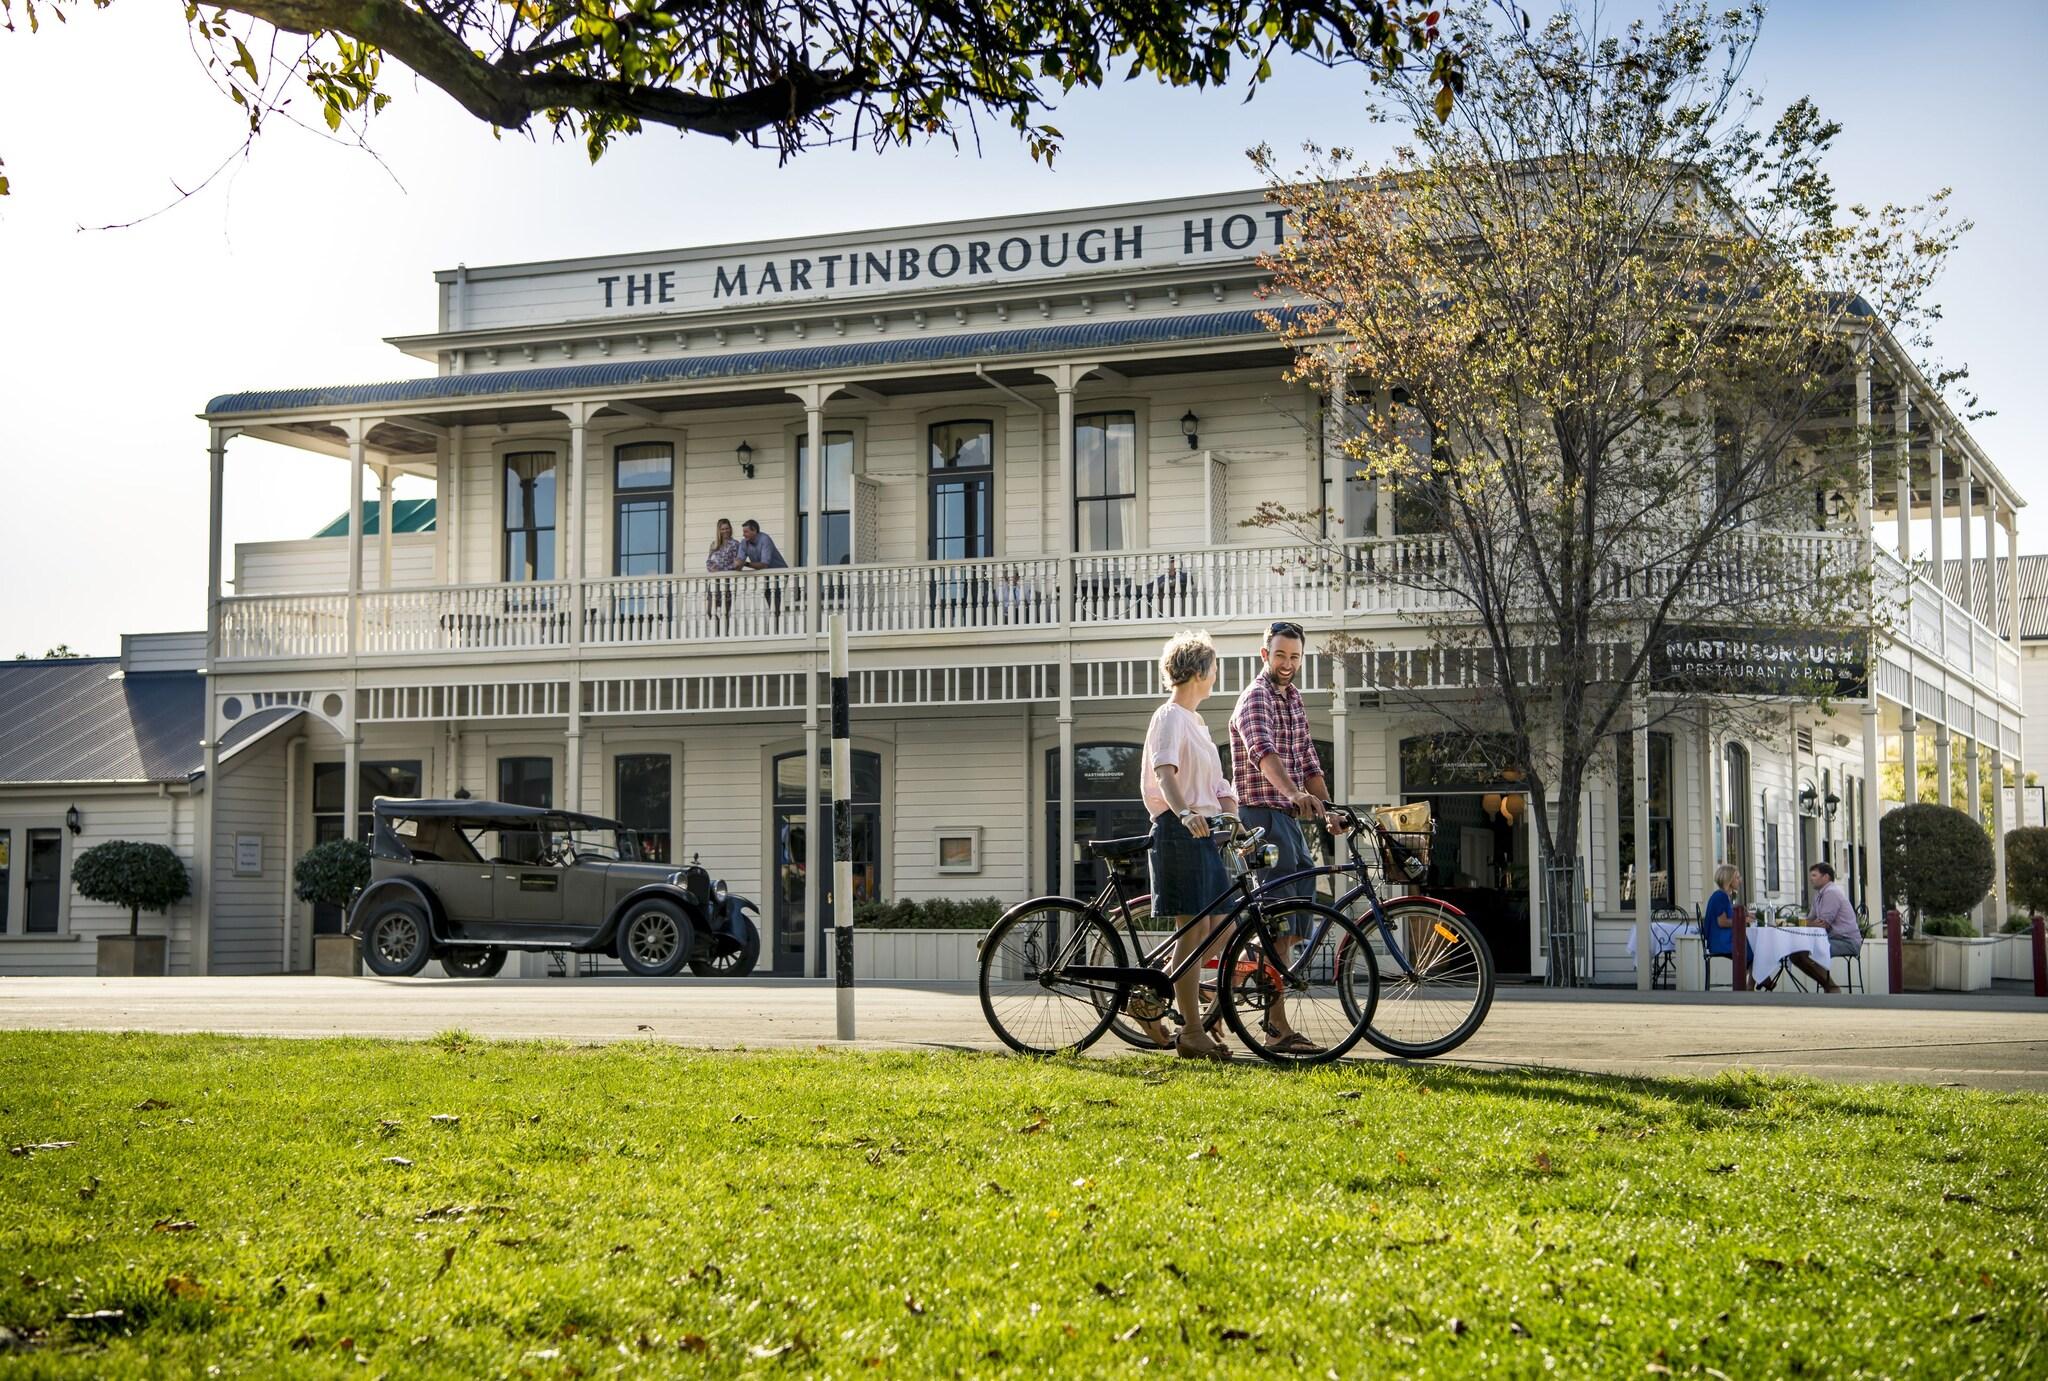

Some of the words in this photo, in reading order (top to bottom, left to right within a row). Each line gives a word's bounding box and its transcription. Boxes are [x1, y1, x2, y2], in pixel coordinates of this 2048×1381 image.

[598, 271, 676, 308] THE
[714, 225, 1143, 299] MARTINBOROUGH
[1790, 667, 1800, 679] &
